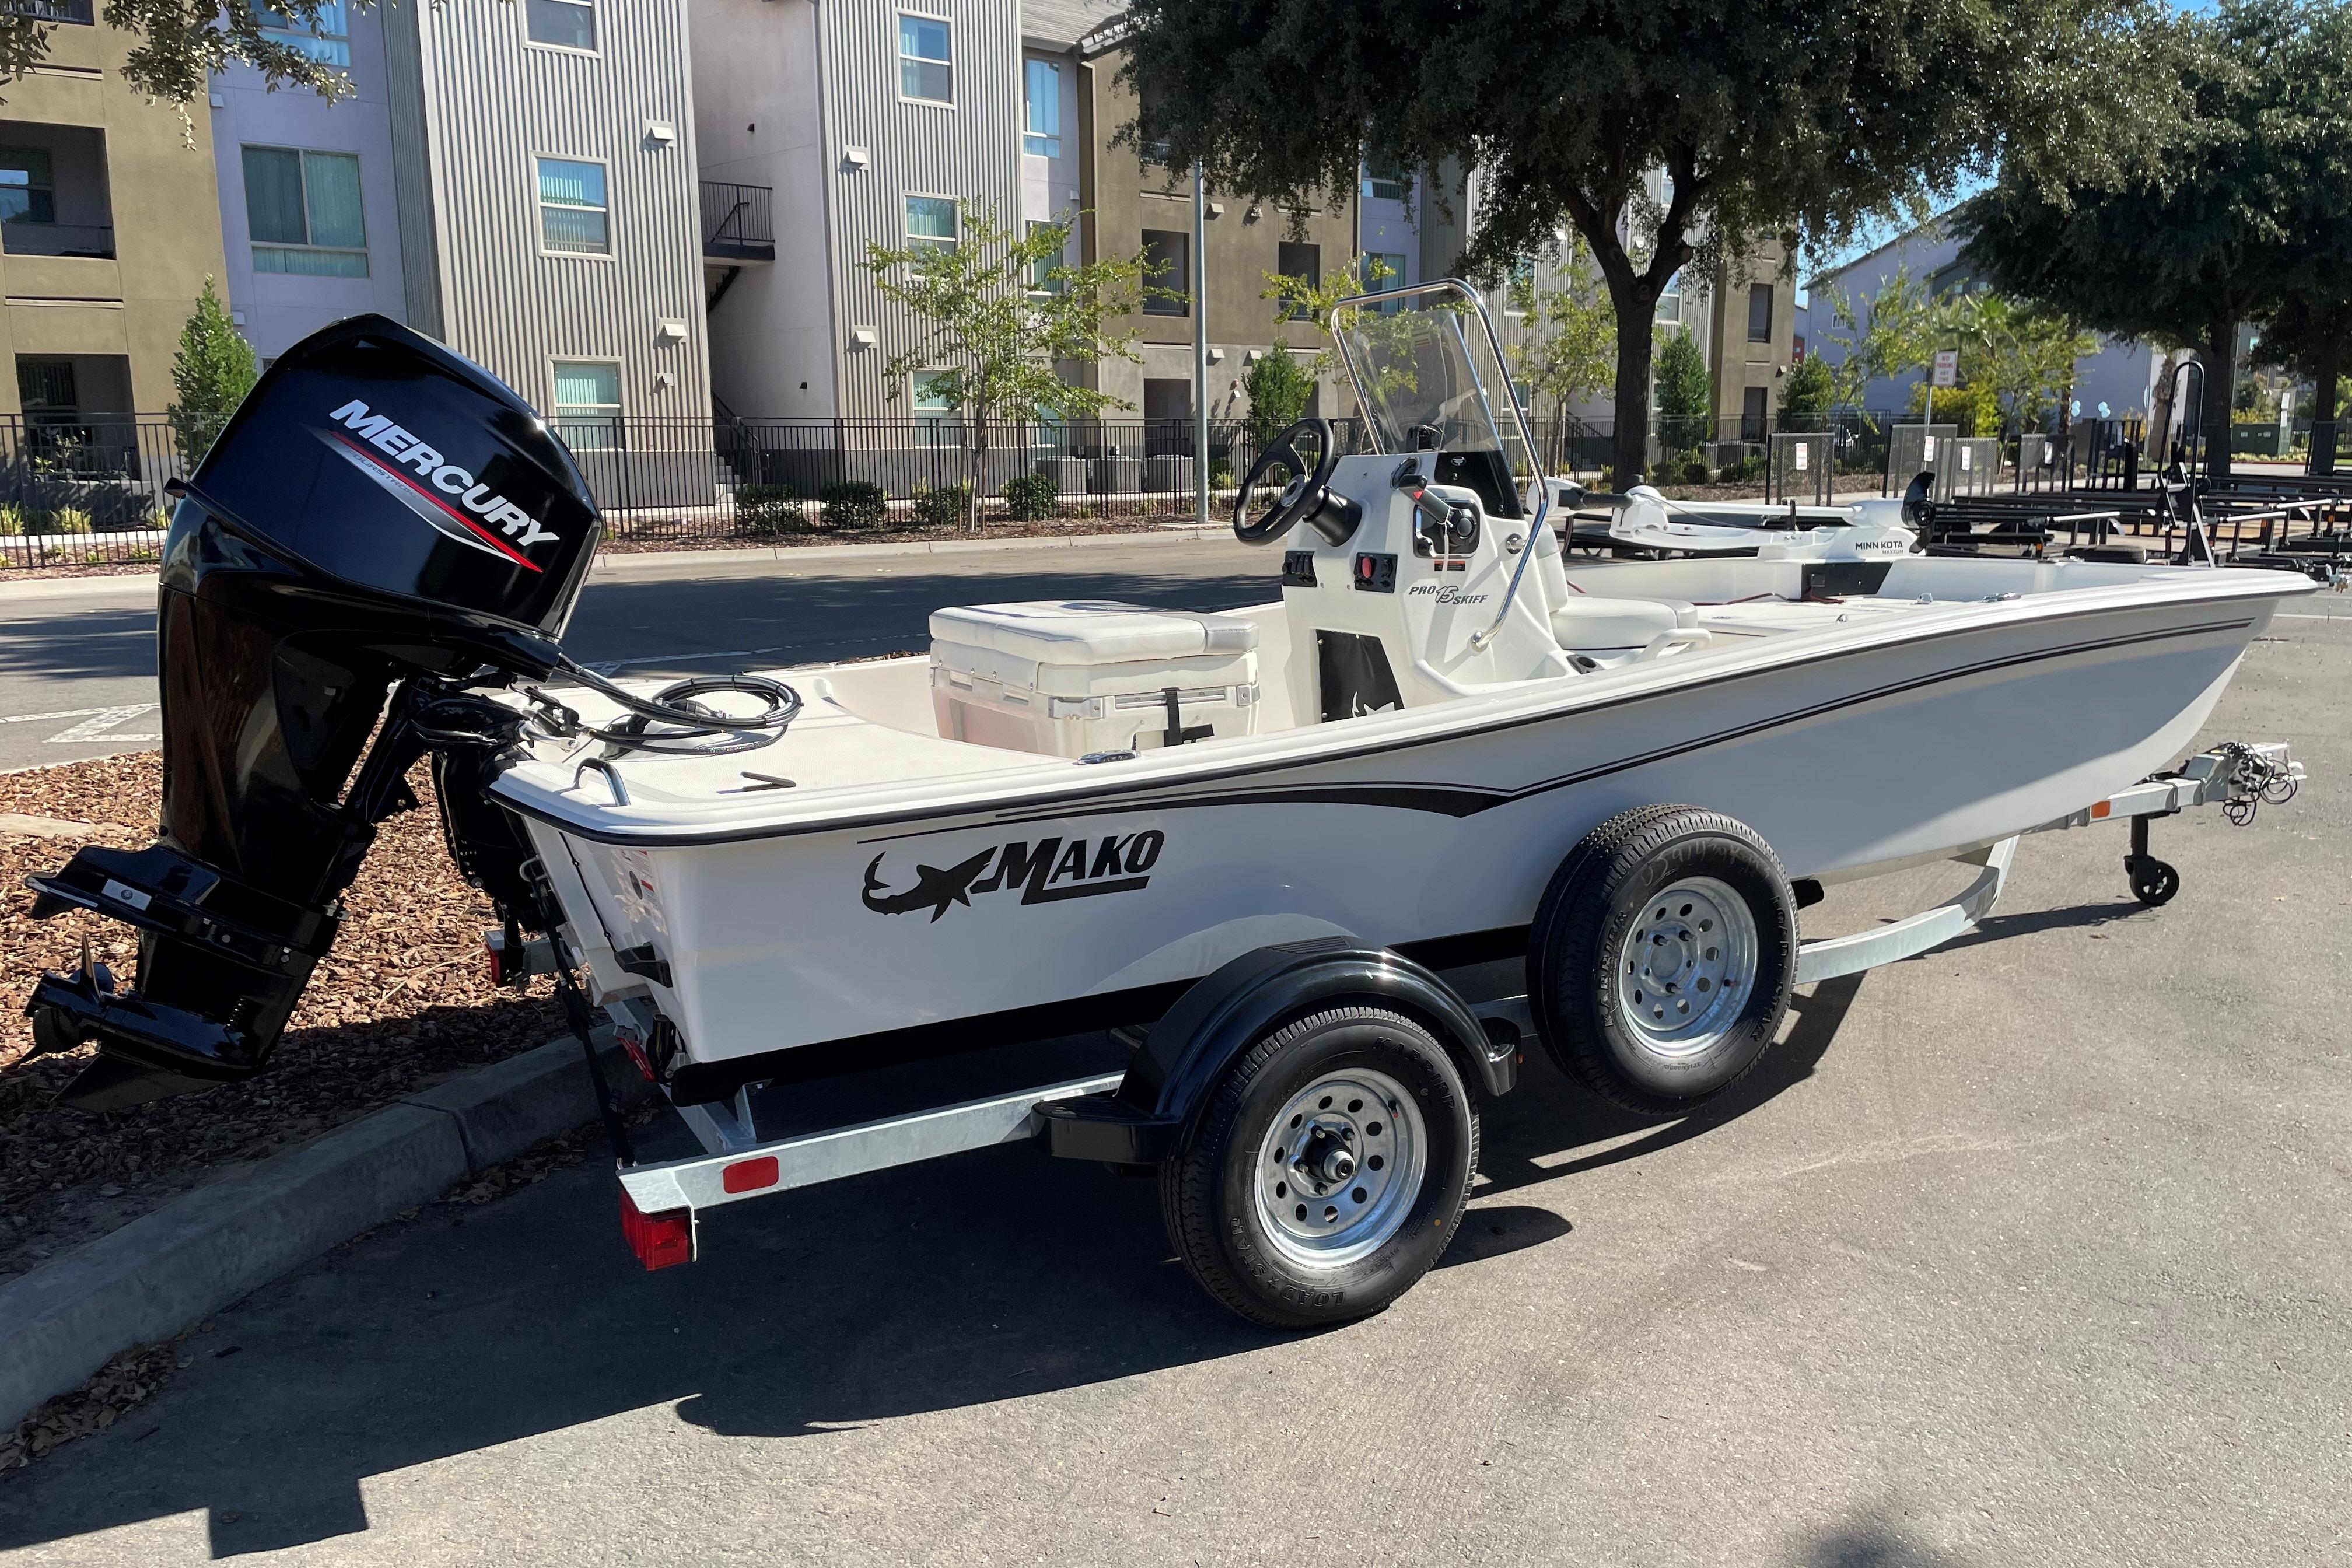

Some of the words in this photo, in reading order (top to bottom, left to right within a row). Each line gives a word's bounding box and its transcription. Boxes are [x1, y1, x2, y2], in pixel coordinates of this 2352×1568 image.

[329, 399, 560, 547] MERCURY
[345, 450, 421, 502] FOURSTROKE
[1856, 541, 1878, 550] MINN
[1409, 586, 1436, 595] PRO
[1436, 586, 1459, 604] 15
[1452, 595, 1489, 604] SKIFF
[970, 830, 1165, 906] MAKO
[1600, 910, 1626, 1027] KARRIER
[1230, 1217, 1266, 1278] STAR
[1282, 1284, 1345, 1307] LOAD
